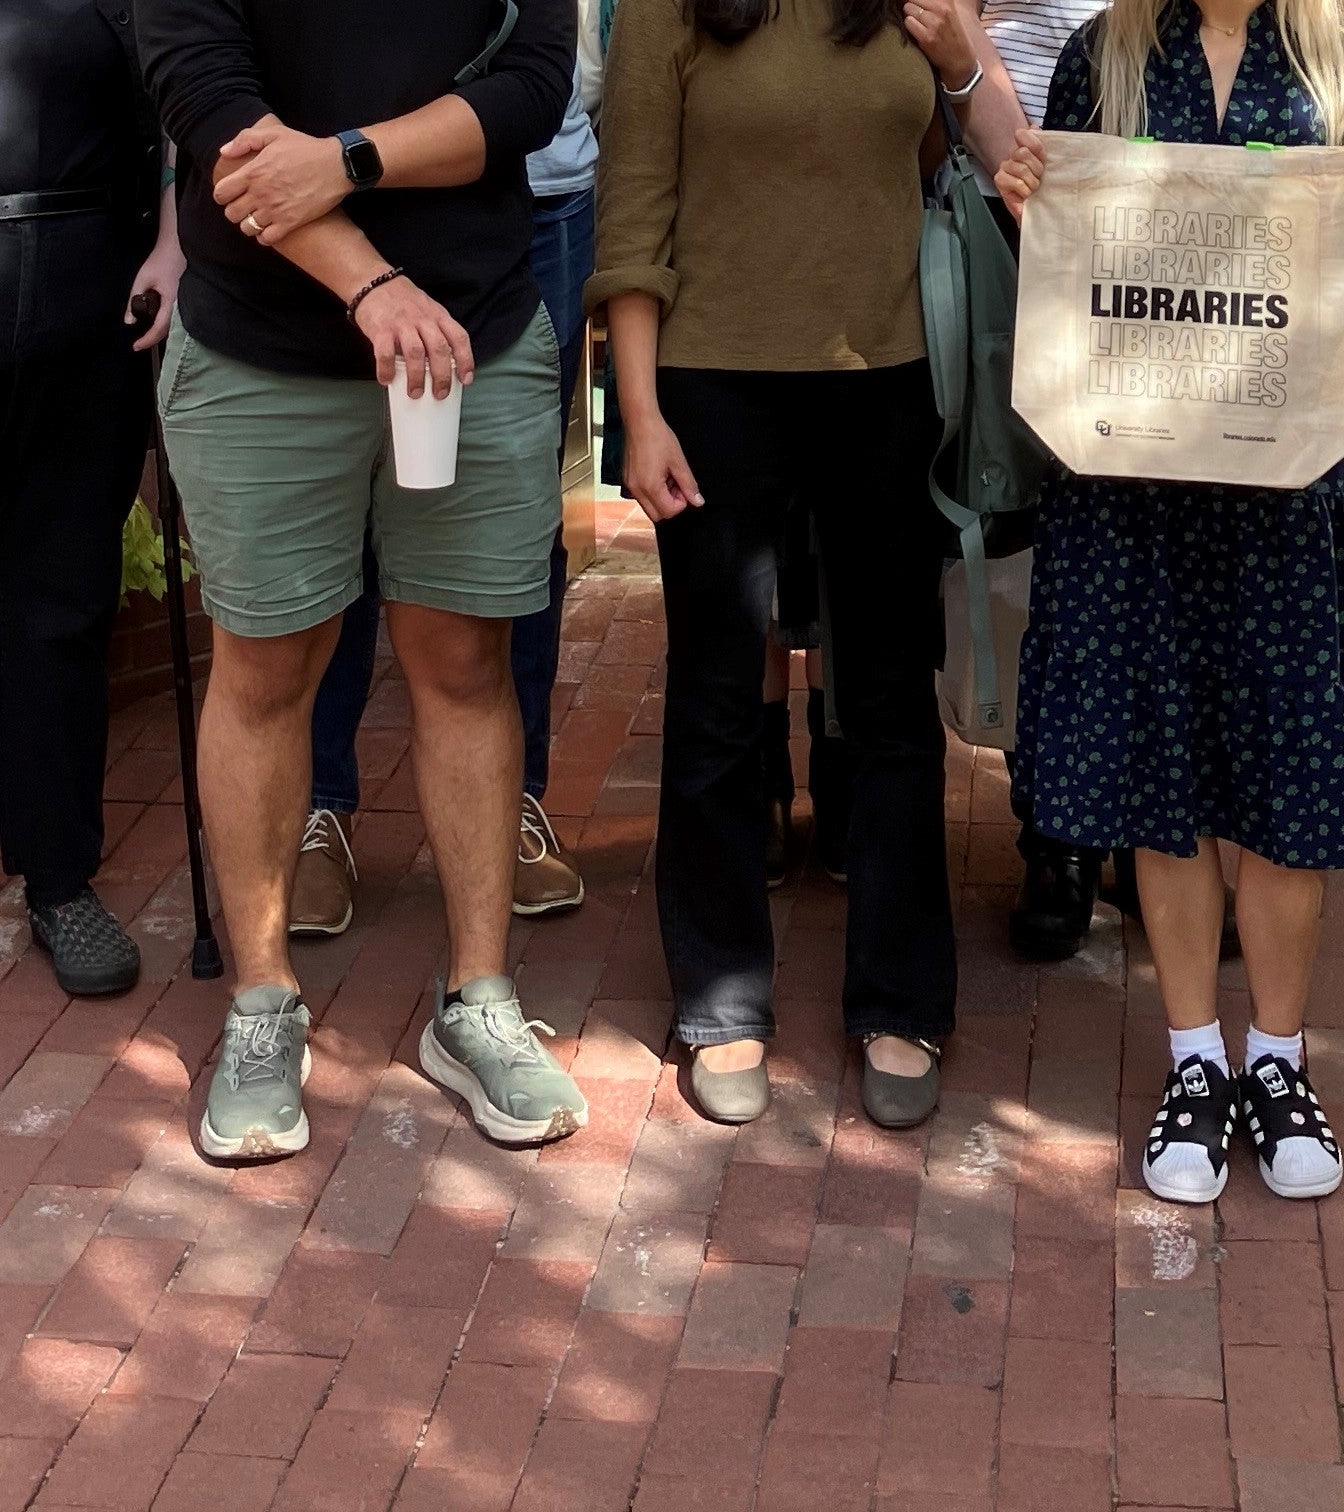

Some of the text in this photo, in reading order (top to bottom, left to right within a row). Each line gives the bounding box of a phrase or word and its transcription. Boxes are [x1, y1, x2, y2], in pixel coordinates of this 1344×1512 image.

[1093, 205, 1293, 253] LIBRARIES
[1091, 244, 1292, 290] LIBRARIES
[1090, 283, 1290, 329] LIBRARIES
[1089, 321, 1289, 369] LIBRARIES
[1087, 360, 1288, 408] LIBRARIES
